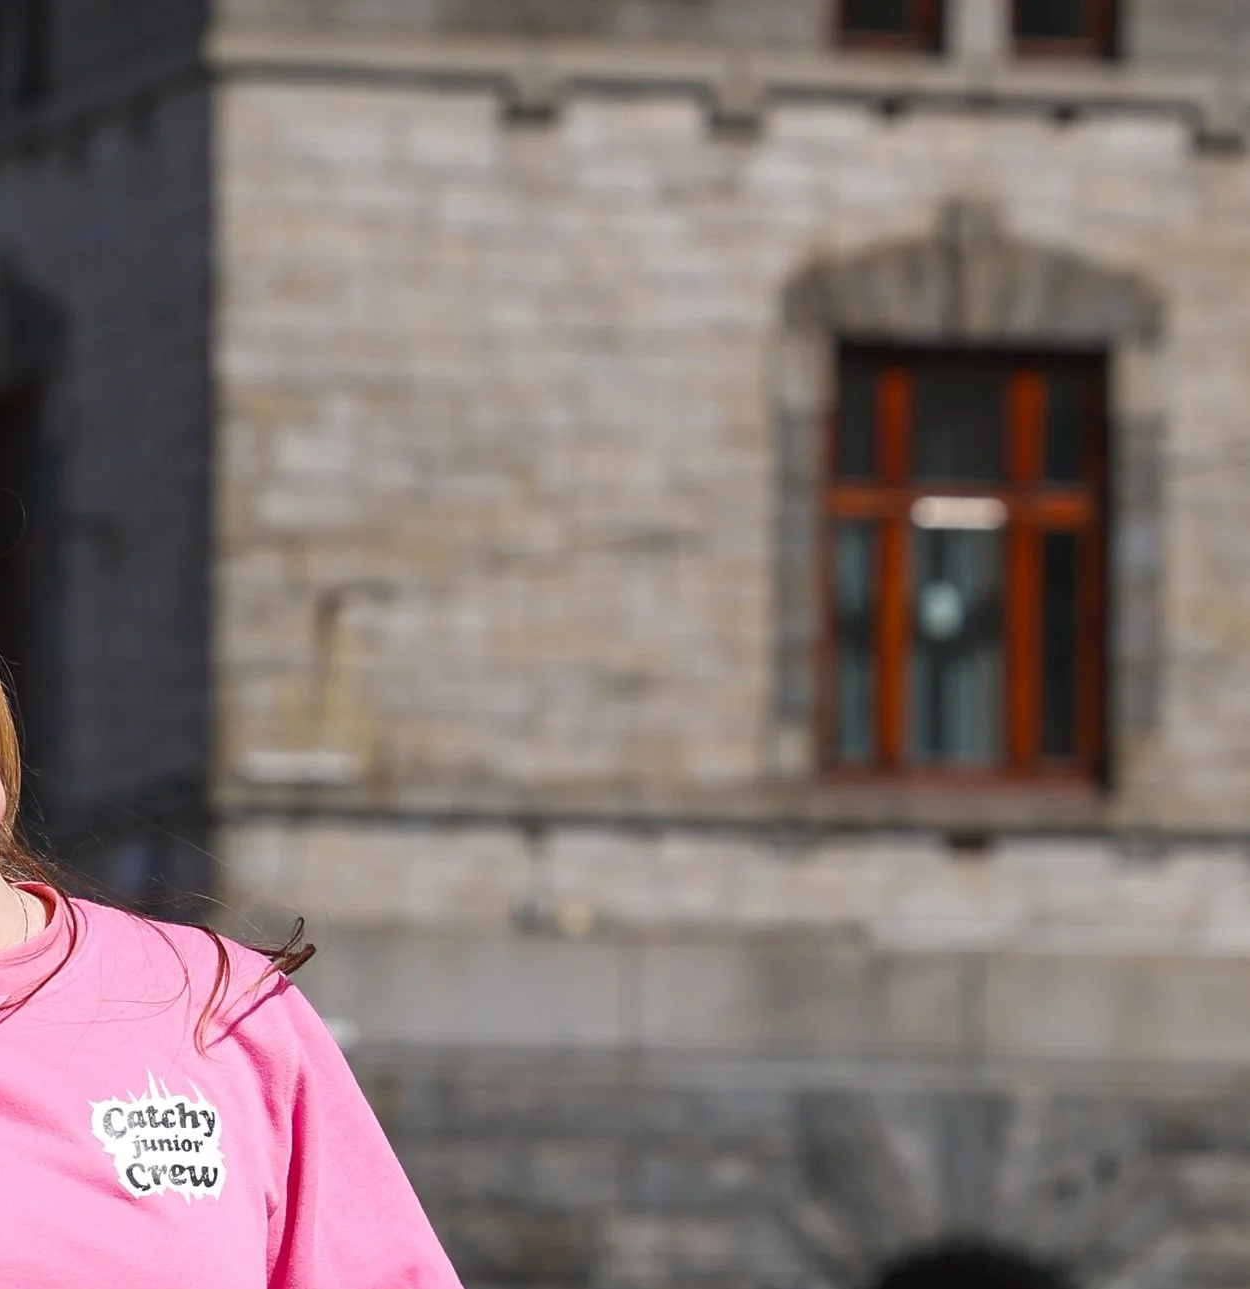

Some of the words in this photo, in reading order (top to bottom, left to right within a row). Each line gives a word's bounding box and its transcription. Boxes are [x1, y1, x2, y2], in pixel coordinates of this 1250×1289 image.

[102, 1102, 216, 1140] Catchy
[132, 1134, 204, 1160] junior
[125, 1162, 219, 1192] Crew
